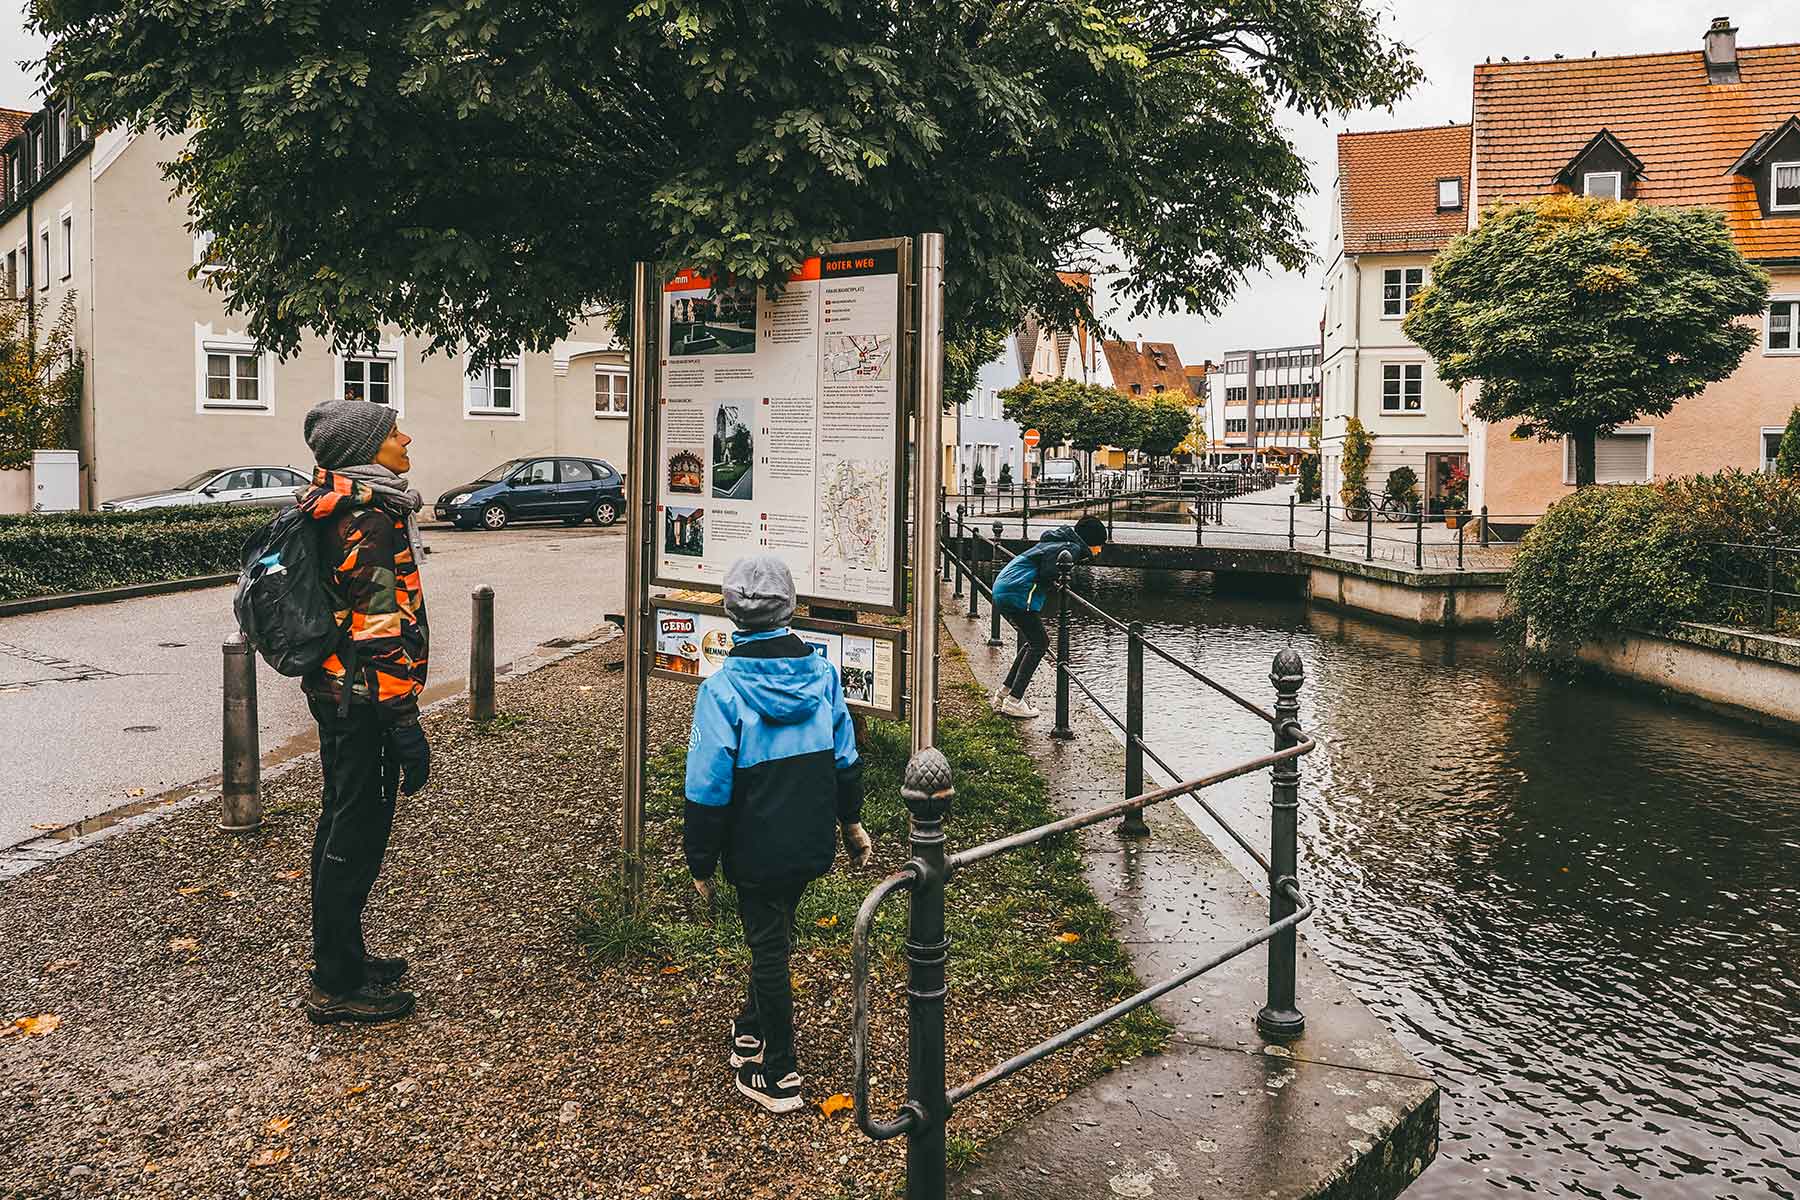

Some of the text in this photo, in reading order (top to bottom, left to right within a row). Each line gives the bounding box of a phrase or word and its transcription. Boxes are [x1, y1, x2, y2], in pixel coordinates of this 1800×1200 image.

[826, 258, 875, 272] ROTER WEG
[662, 620, 692, 632] GEFRO
[704, 646, 729, 657] MEMMIN
